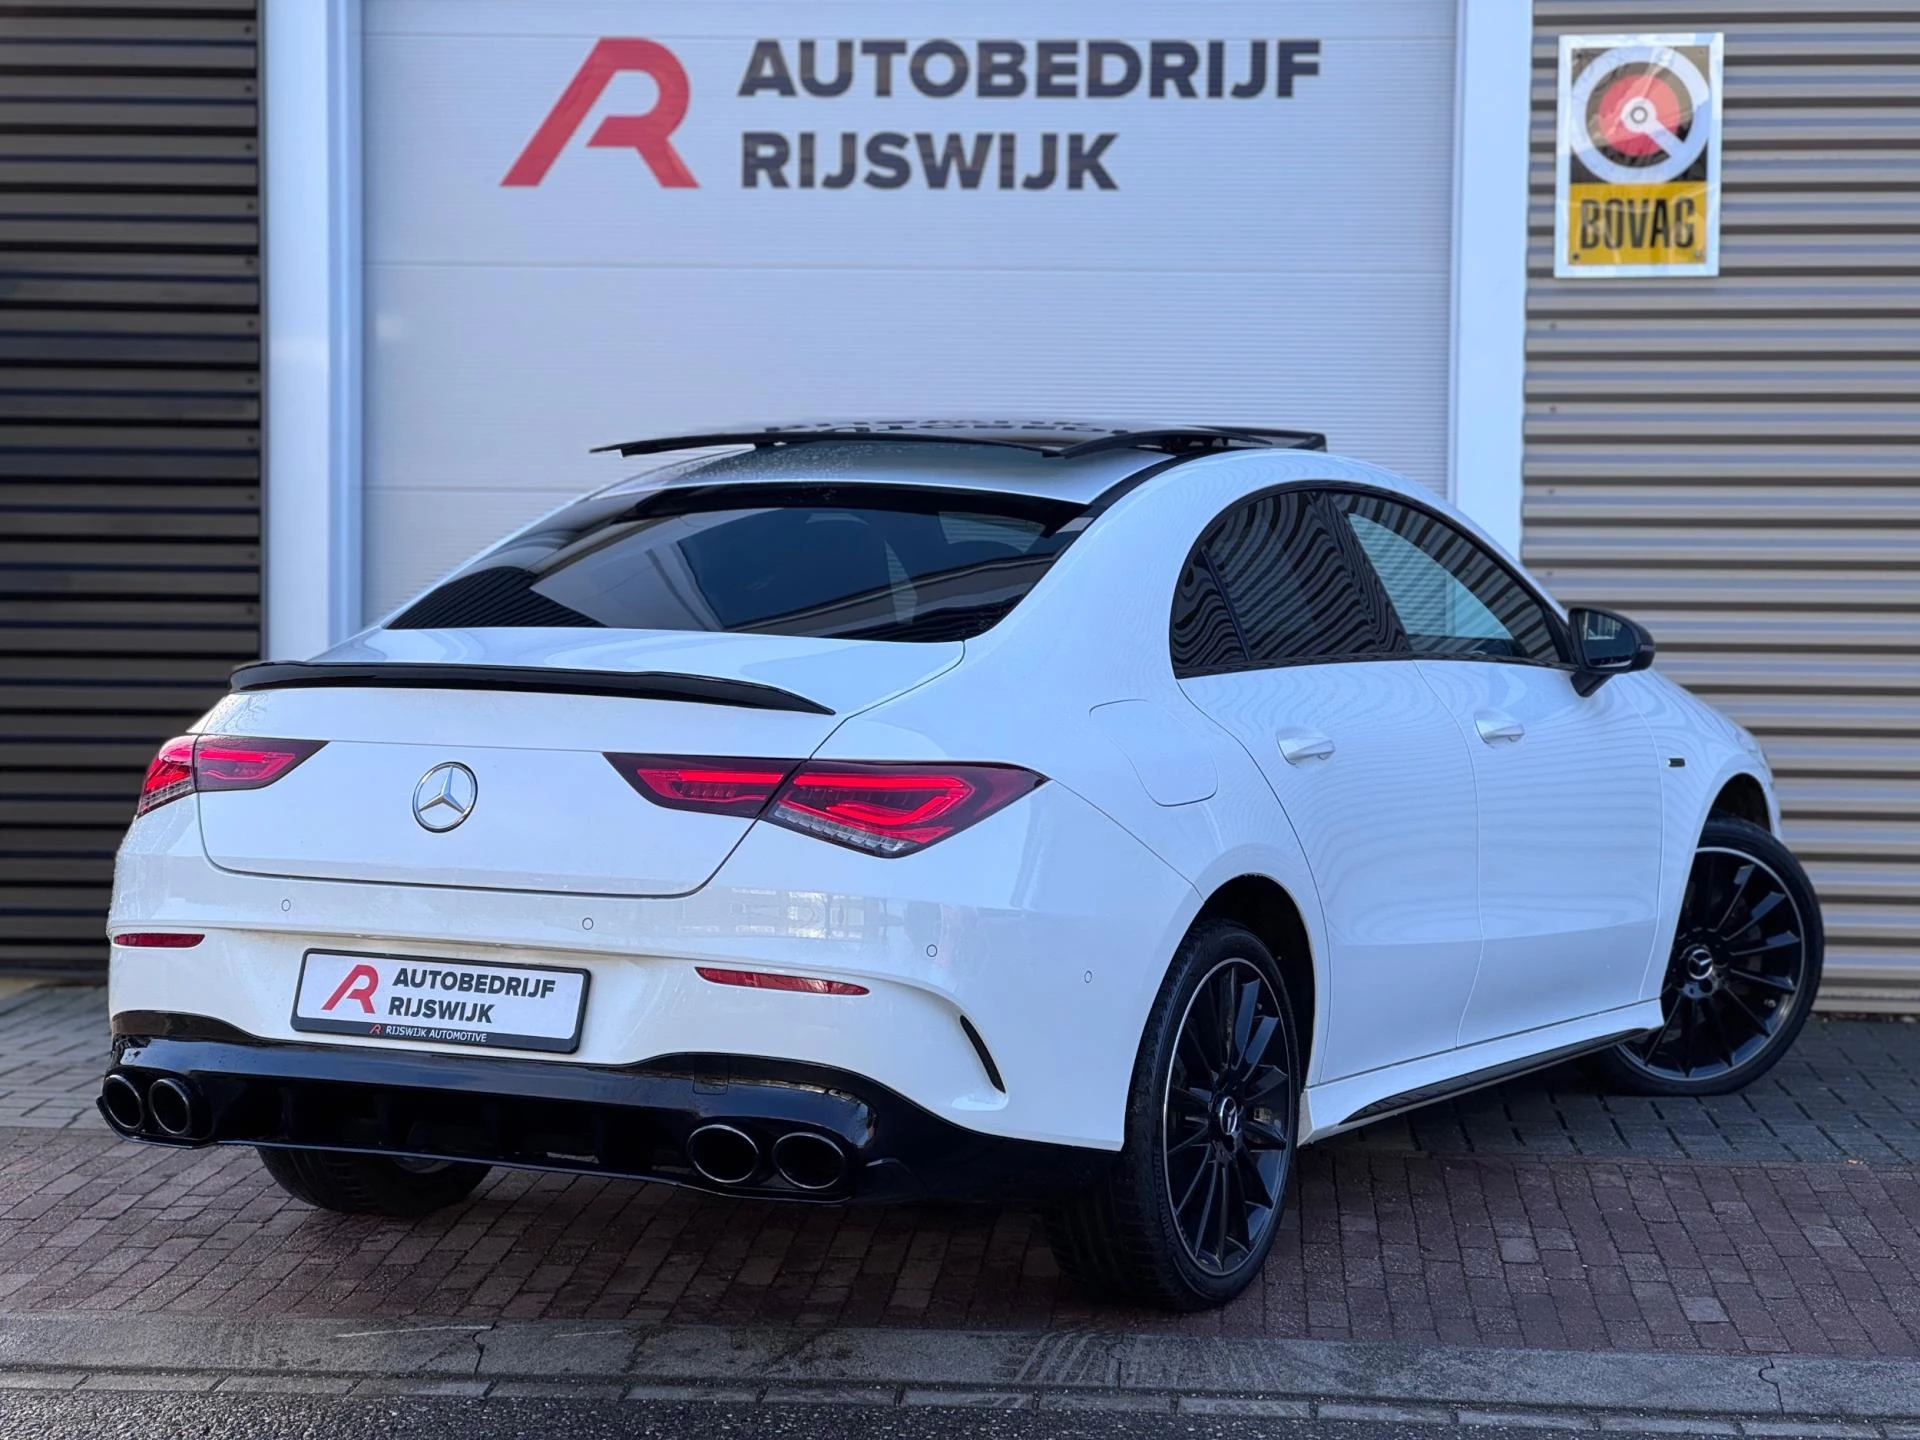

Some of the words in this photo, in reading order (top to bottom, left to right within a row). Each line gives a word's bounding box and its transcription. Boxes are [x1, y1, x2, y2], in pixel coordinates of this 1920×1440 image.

[738, 39, 1321, 98] AUTOBEDRIJF
[742, 132, 1119, 191] RIJSWIJK
[392, 967, 556, 999] AUTOBEDRIJF
[388, 996, 495, 1024] RIJSWIJK
[386, 1025, 426, 1038] RIJSWIJK
[428, 1029, 487, 1043] AUTOMOTIVE
